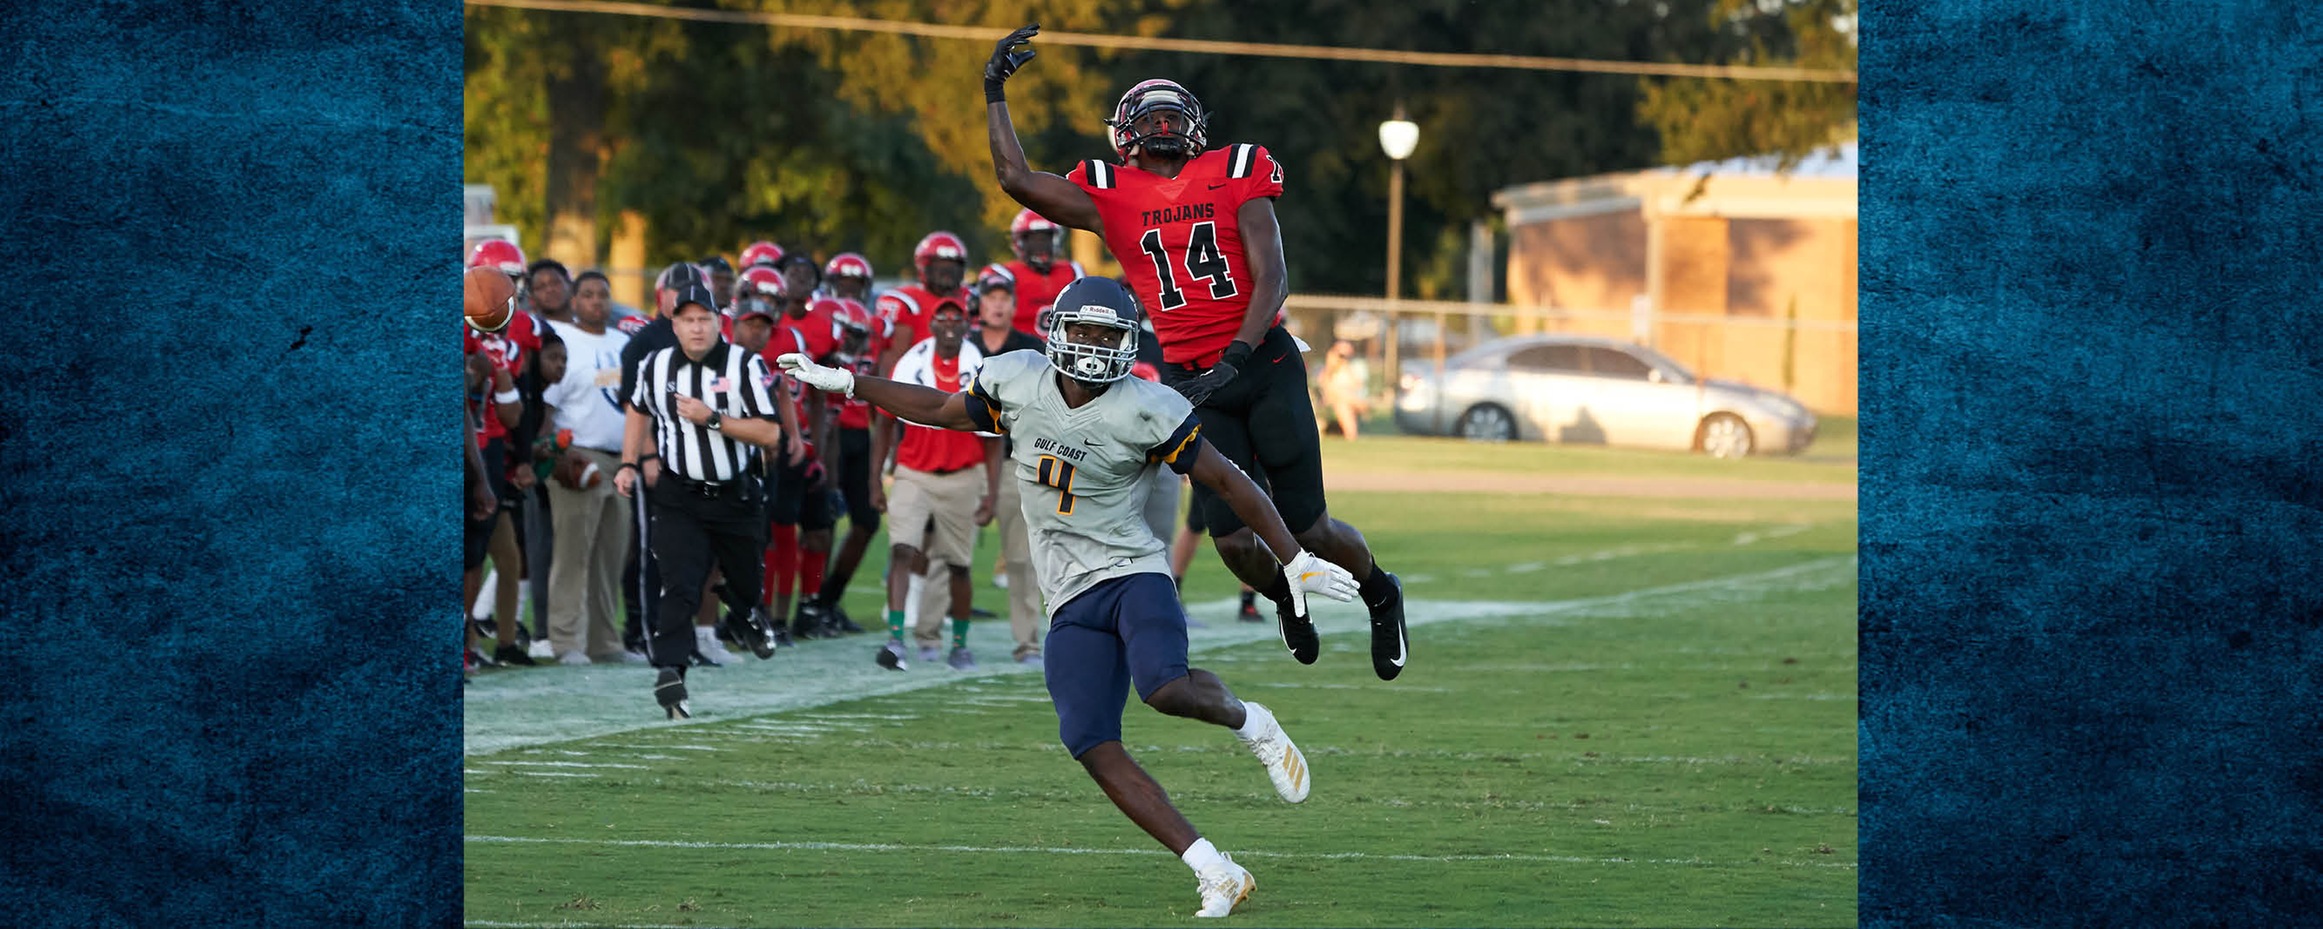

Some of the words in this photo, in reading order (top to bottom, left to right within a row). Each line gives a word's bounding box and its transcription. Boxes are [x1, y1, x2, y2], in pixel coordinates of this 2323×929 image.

[1142, 203, 1215, 226] TROJANS
[1140, 221, 1239, 312] 14
[1034, 437, 1057, 452] GULF
[1056, 444, 1088, 461] COAST
[1036, 453, 1077, 516] 4
